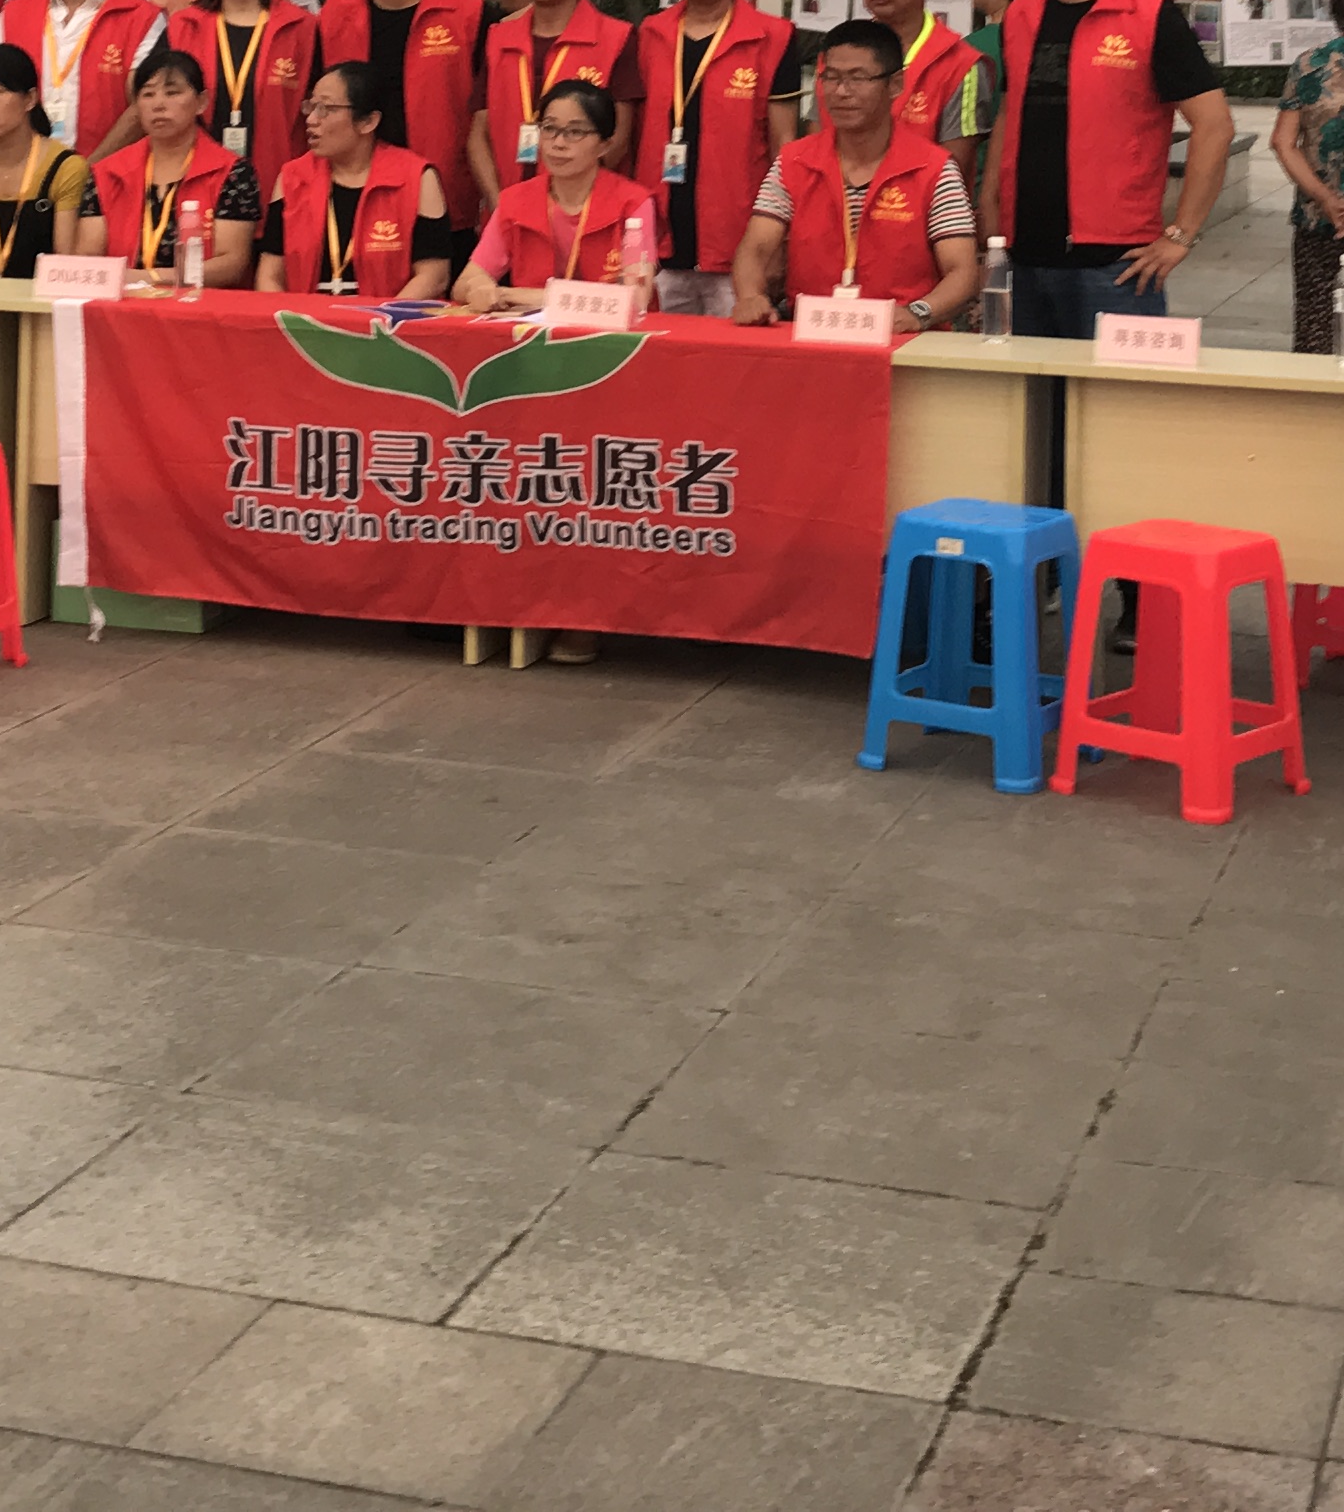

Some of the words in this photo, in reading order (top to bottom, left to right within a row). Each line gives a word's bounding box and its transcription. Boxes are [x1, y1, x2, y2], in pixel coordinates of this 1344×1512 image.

[225, 418, 739, 517] 江阴寻亲志愿者
[225, 495, 381, 544] Jiangyin
[384, 511, 519, 553] tracing
[529, 511, 736, 555] Volunteers
